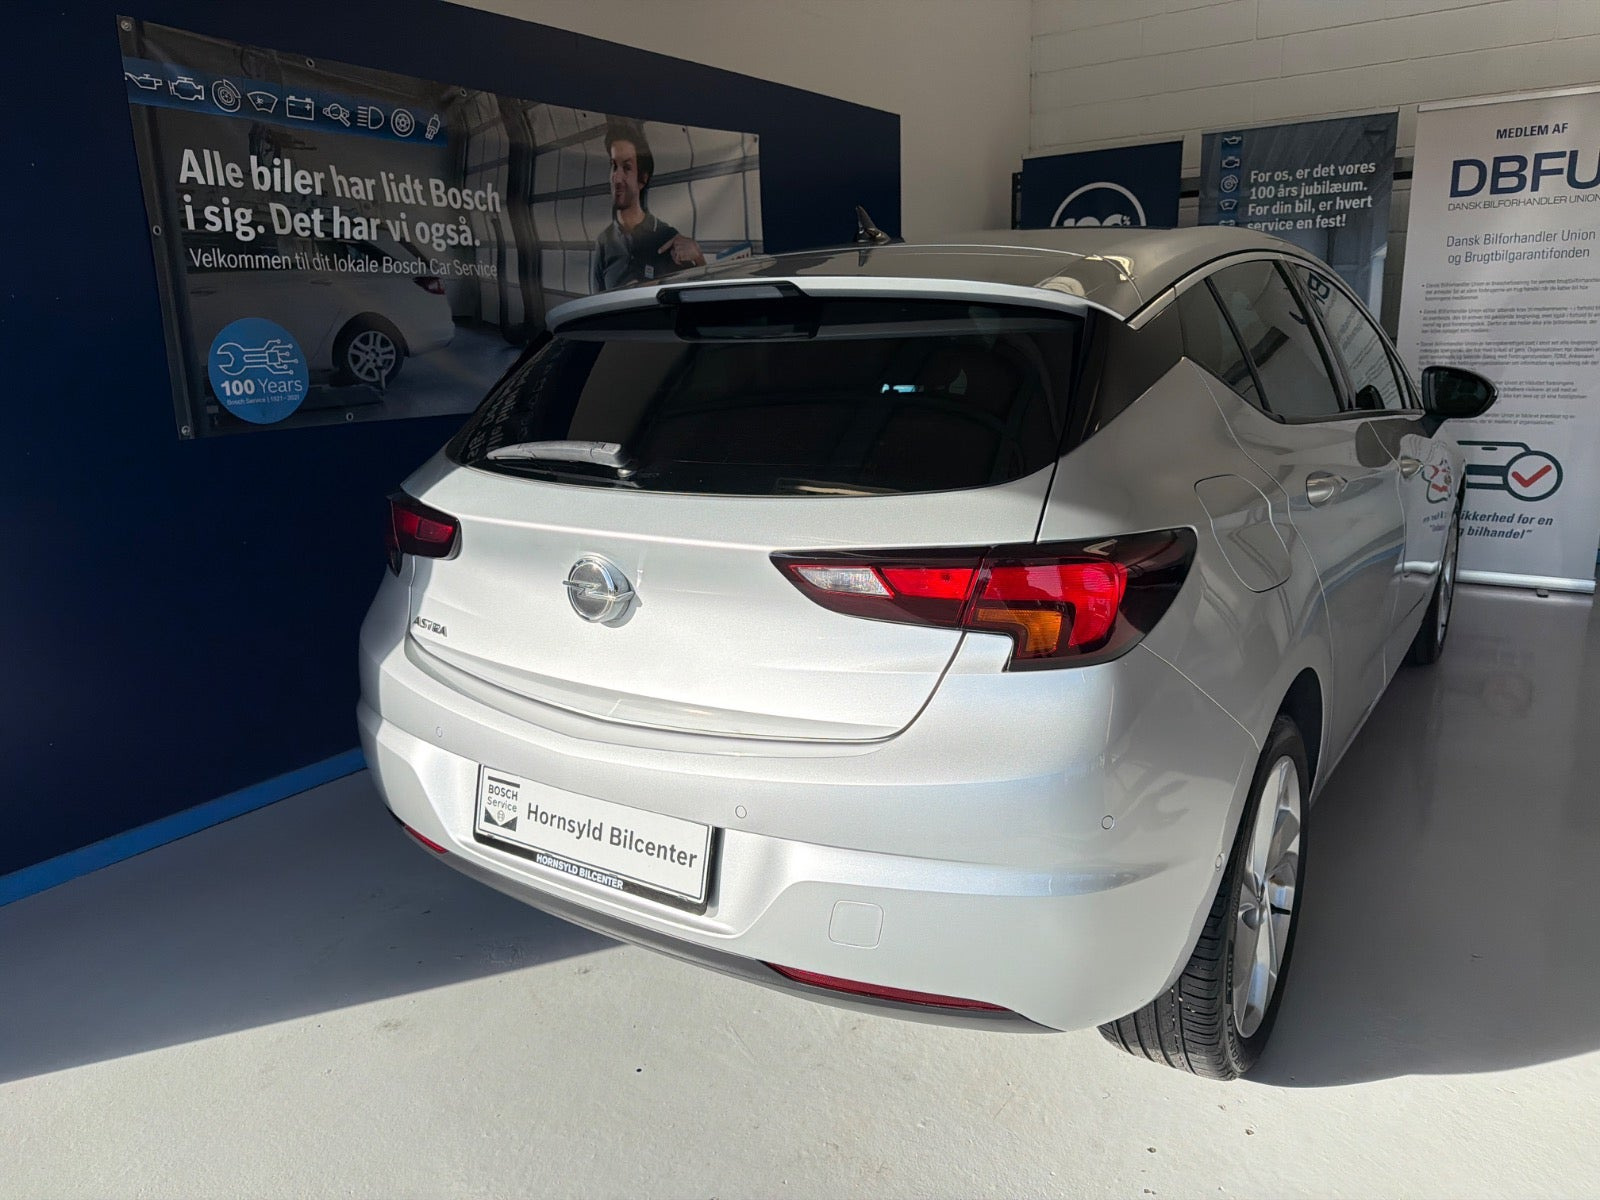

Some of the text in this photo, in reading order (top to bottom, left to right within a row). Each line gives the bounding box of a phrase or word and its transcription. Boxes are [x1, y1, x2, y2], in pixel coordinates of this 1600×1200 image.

[1496, 122, 1569, 140] MEDLEM AF
[179, 149, 501, 213] Alle biler har lidt Bosch
[1250, 162, 1376, 183] For os, er det vores
[1449, 149, 1600, 198] DBFU
[1250, 180, 1368, 200] 100 års jubilæum.
[1248, 195, 1373, 216] For din bil, er hvert
[1447, 201, 1482, 212] DANSK
[1483, 196, 1568, 209] BILFORHANDLER
[183, 194, 481, 252] i sig. Det har vi også.
[1248, 213, 1347, 232] service en fest!
[1446, 228, 1596, 247] Dansk Bilforhandler Union
[189, 248, 498, 277] Velkommen til dit lokale Bosch Car Service
[1447, 246, 1590, 266] og Brugtbilgarantifonden
[221, 378, 303, 396] 100 Years
[1459, 510, 1554, 526] ikkerhed for en
[488, 784, 518, 802] BOSCH
[487, 795, 518, 813] Service
[527, 802, 698, 868] Hornsyld Bilcenter
[536, 854, 624, 891] HORNSYLD BILCENTER
